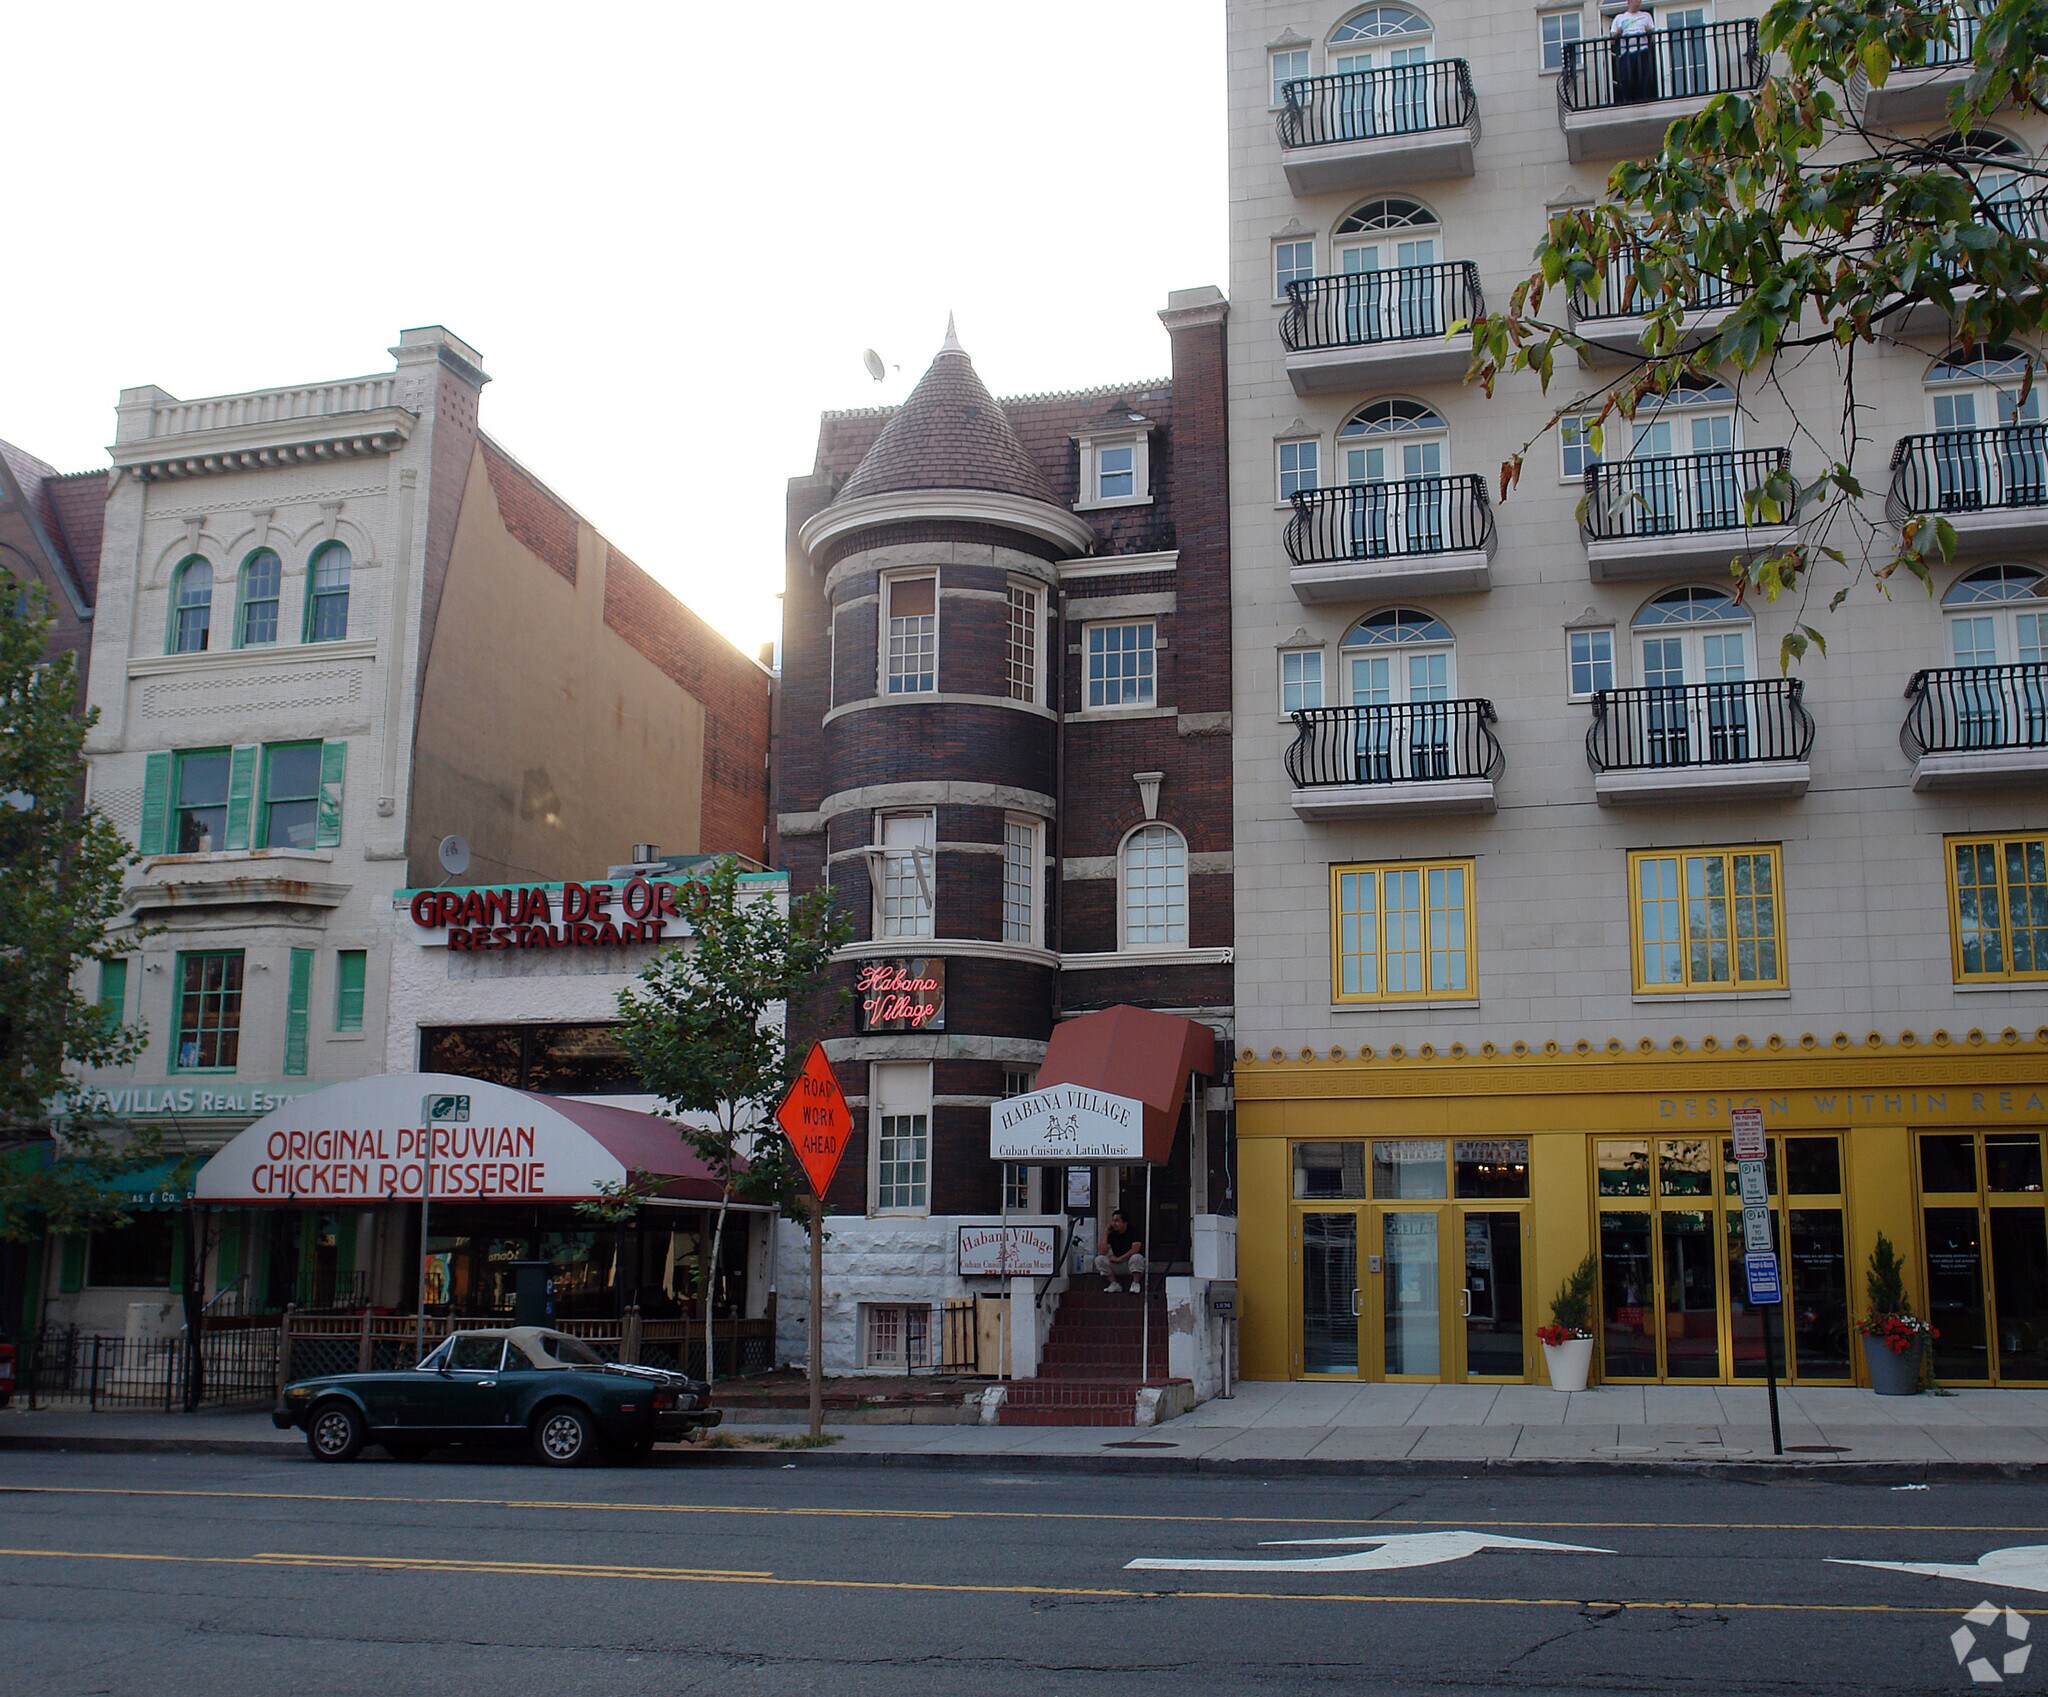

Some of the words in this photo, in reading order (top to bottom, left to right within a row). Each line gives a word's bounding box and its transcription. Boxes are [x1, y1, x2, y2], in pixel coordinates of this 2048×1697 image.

[410, 887, 551, 928] GRANJA
[562, 882, 613, 922] DE
[448, 919, 667, 950] RESTAURANT
[857, 966, 937, 991] Habana
[863, 995, 934, 1026] Village
[804, 1078, 836, 1098] ROAD
[459, 1096, 468, 1106] 2
[1001, 1093, 1062, 1130] HABANA
[1067, 1091, 1131, 1127] VILLAGE
[1814, 1093, 1947, 1114] WITHIN
[1972, 1092, 2045, 1111] REA
[803, 1107, 835, 1127] WORK
[267, 1129, 389, 1161] ORIGINAL
[396, 1126, 534, 1160] PERUVIAN
[803, 1135, 836, 1154] AHEAD
[999, 1144, 1028, 1156] Cuban
[1031, 1144, 1064, 1155] Cuisine
[1075, 1144, 1100, 1155] Latin
[1101, 1144, 1129, 1155] Music
[252, 1163, 368, 1193] CHICKEN
[379, 1162, 544, 1193] ROTISSERIE
[962, 1231, 1009, 1252] Habana
[1013, 1228, 1052, 1254] Village
